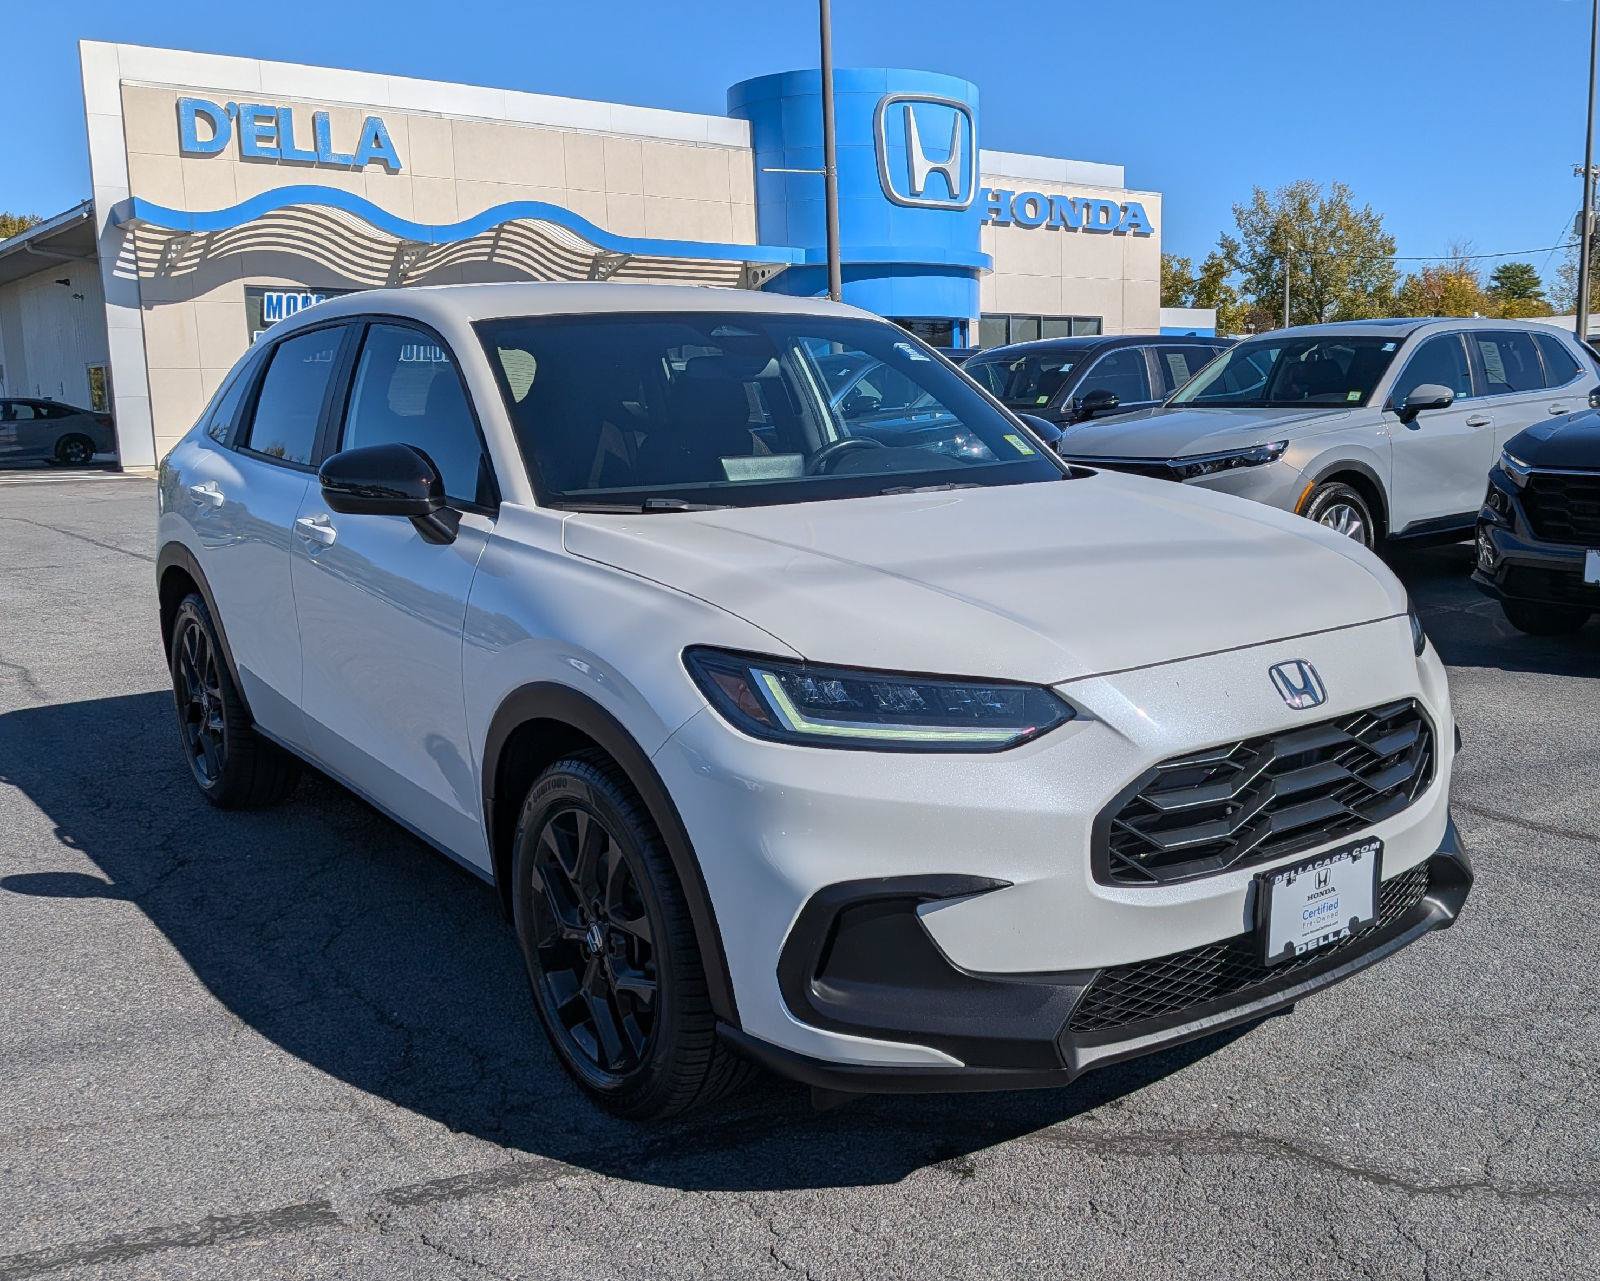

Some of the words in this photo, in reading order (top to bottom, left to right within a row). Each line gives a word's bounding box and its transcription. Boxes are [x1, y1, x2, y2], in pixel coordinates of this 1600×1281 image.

[176, 97, 402, 174] D'ELLA
[980, 187, 1154, 237] HONDA
[1275, 841, 1380, 885] DELLACARS.COM
[1302, 898, 1339, 920] Certified
[1306, 886, 1336, 901] HONDA
[1295, 928, 1351, 956] DELLA
